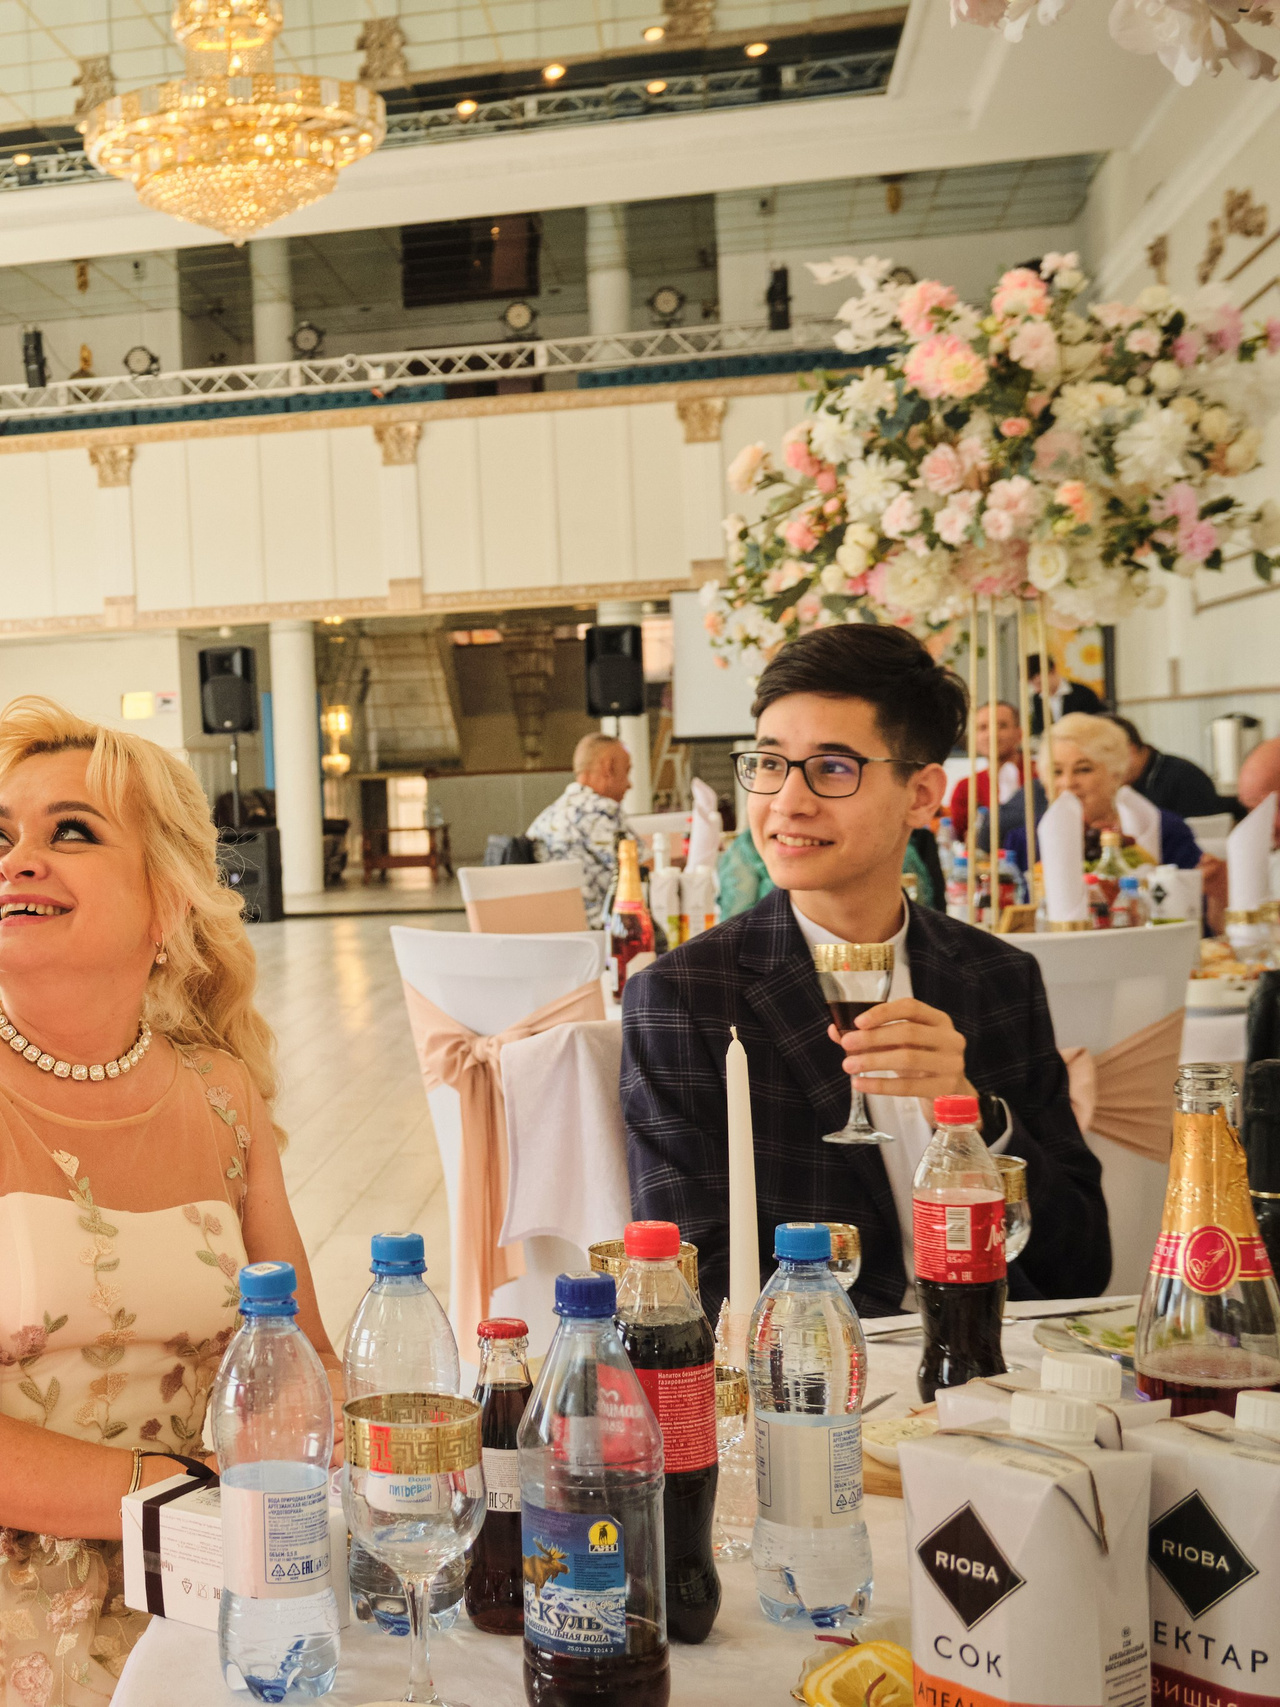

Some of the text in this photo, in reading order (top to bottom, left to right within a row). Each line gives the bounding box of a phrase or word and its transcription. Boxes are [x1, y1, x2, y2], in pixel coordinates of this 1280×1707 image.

[935, 1550, 999, 1584] RIOBA
[1161, 1539, 1230, 1574] RIOBA
[567, 1645, 590, 1653] 25.01.23
[582, 1633, 609, 1643] ВОДА
[933, 1635, 1003, 1678] СОК
[1151, 1676, 1238, 1707] ВИШН
